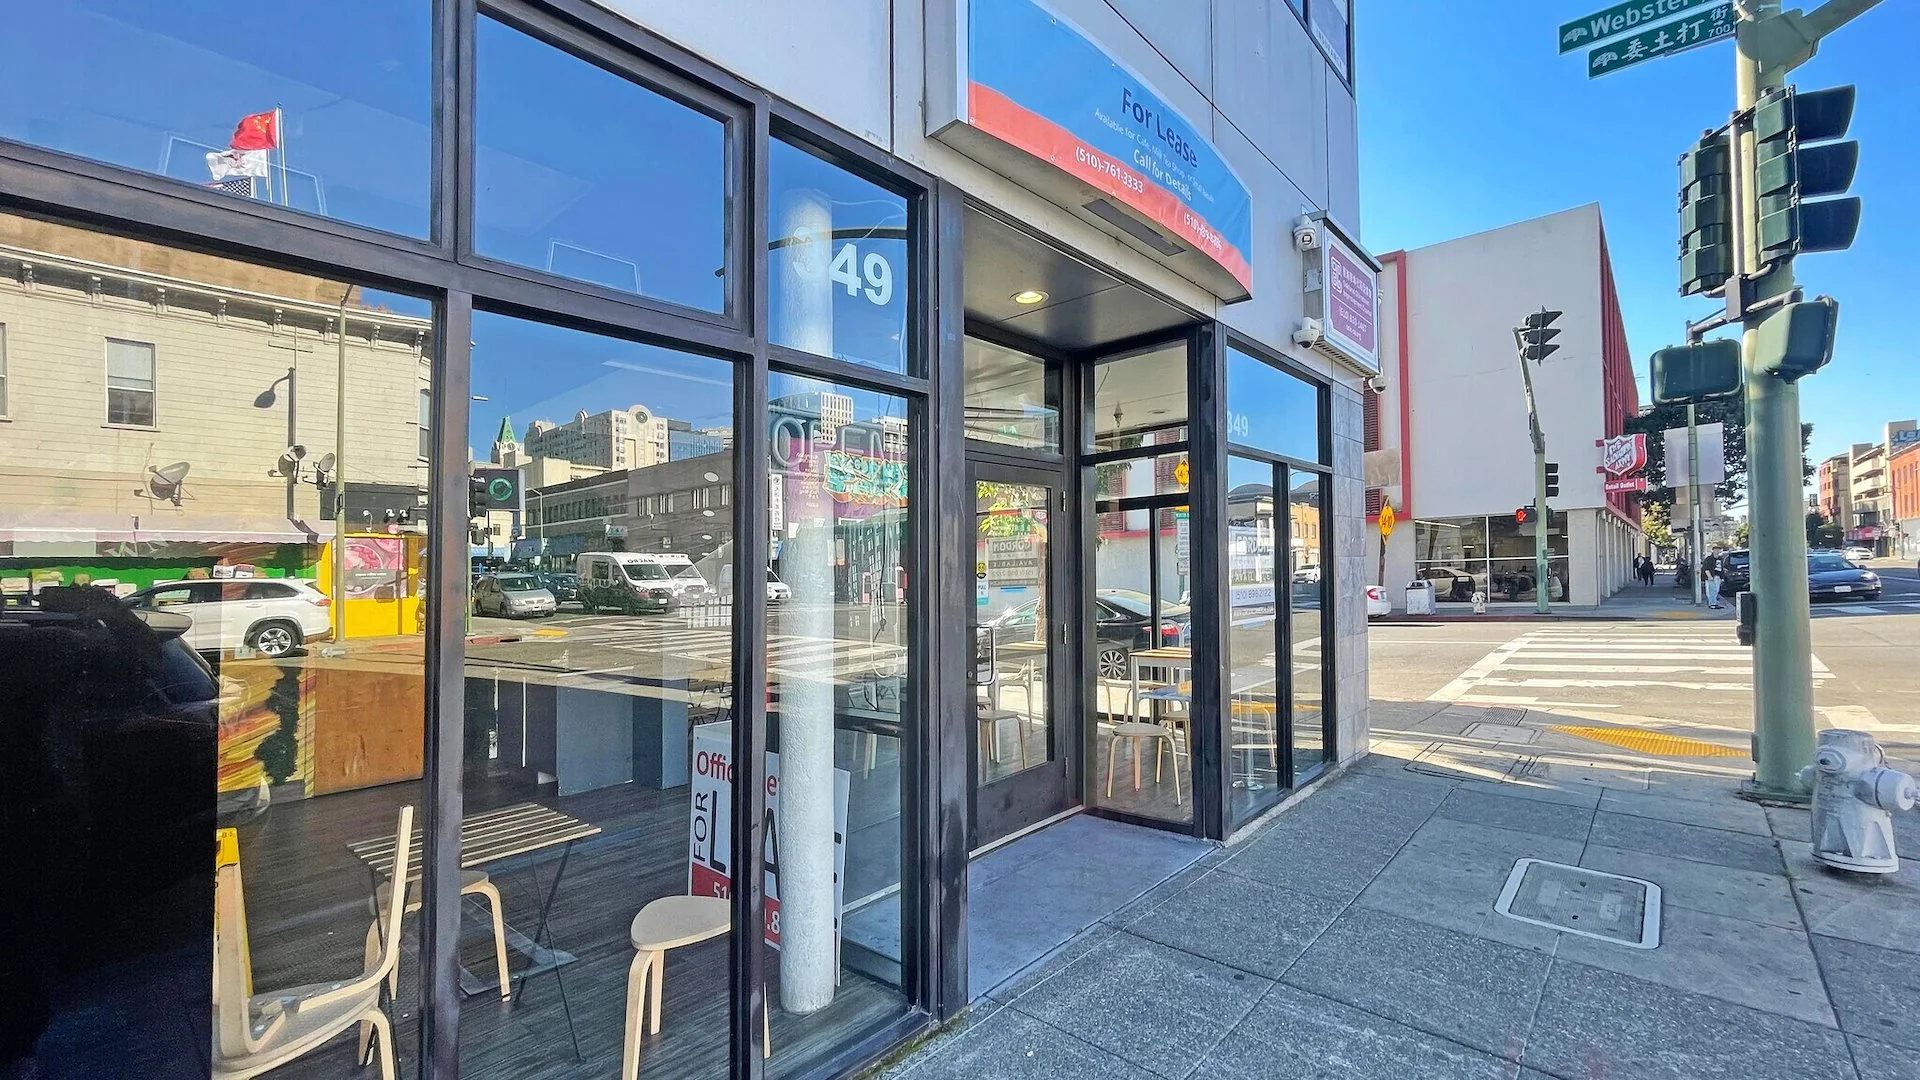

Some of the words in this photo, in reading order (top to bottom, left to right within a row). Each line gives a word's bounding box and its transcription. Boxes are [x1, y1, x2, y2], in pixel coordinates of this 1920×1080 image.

[1708, 23, 1731, 38] 700
[1094, 107, 1125, 135] Available
[1121, 87, 1153, 129] For
[1156, 113, 1198, 168] Lease
[1133, 148, 1152, 172] Call
[1152, 161, 1164, 181] for
[1165, 172, 1193, 201] Details
[693, 792, 708, 862] FOR
